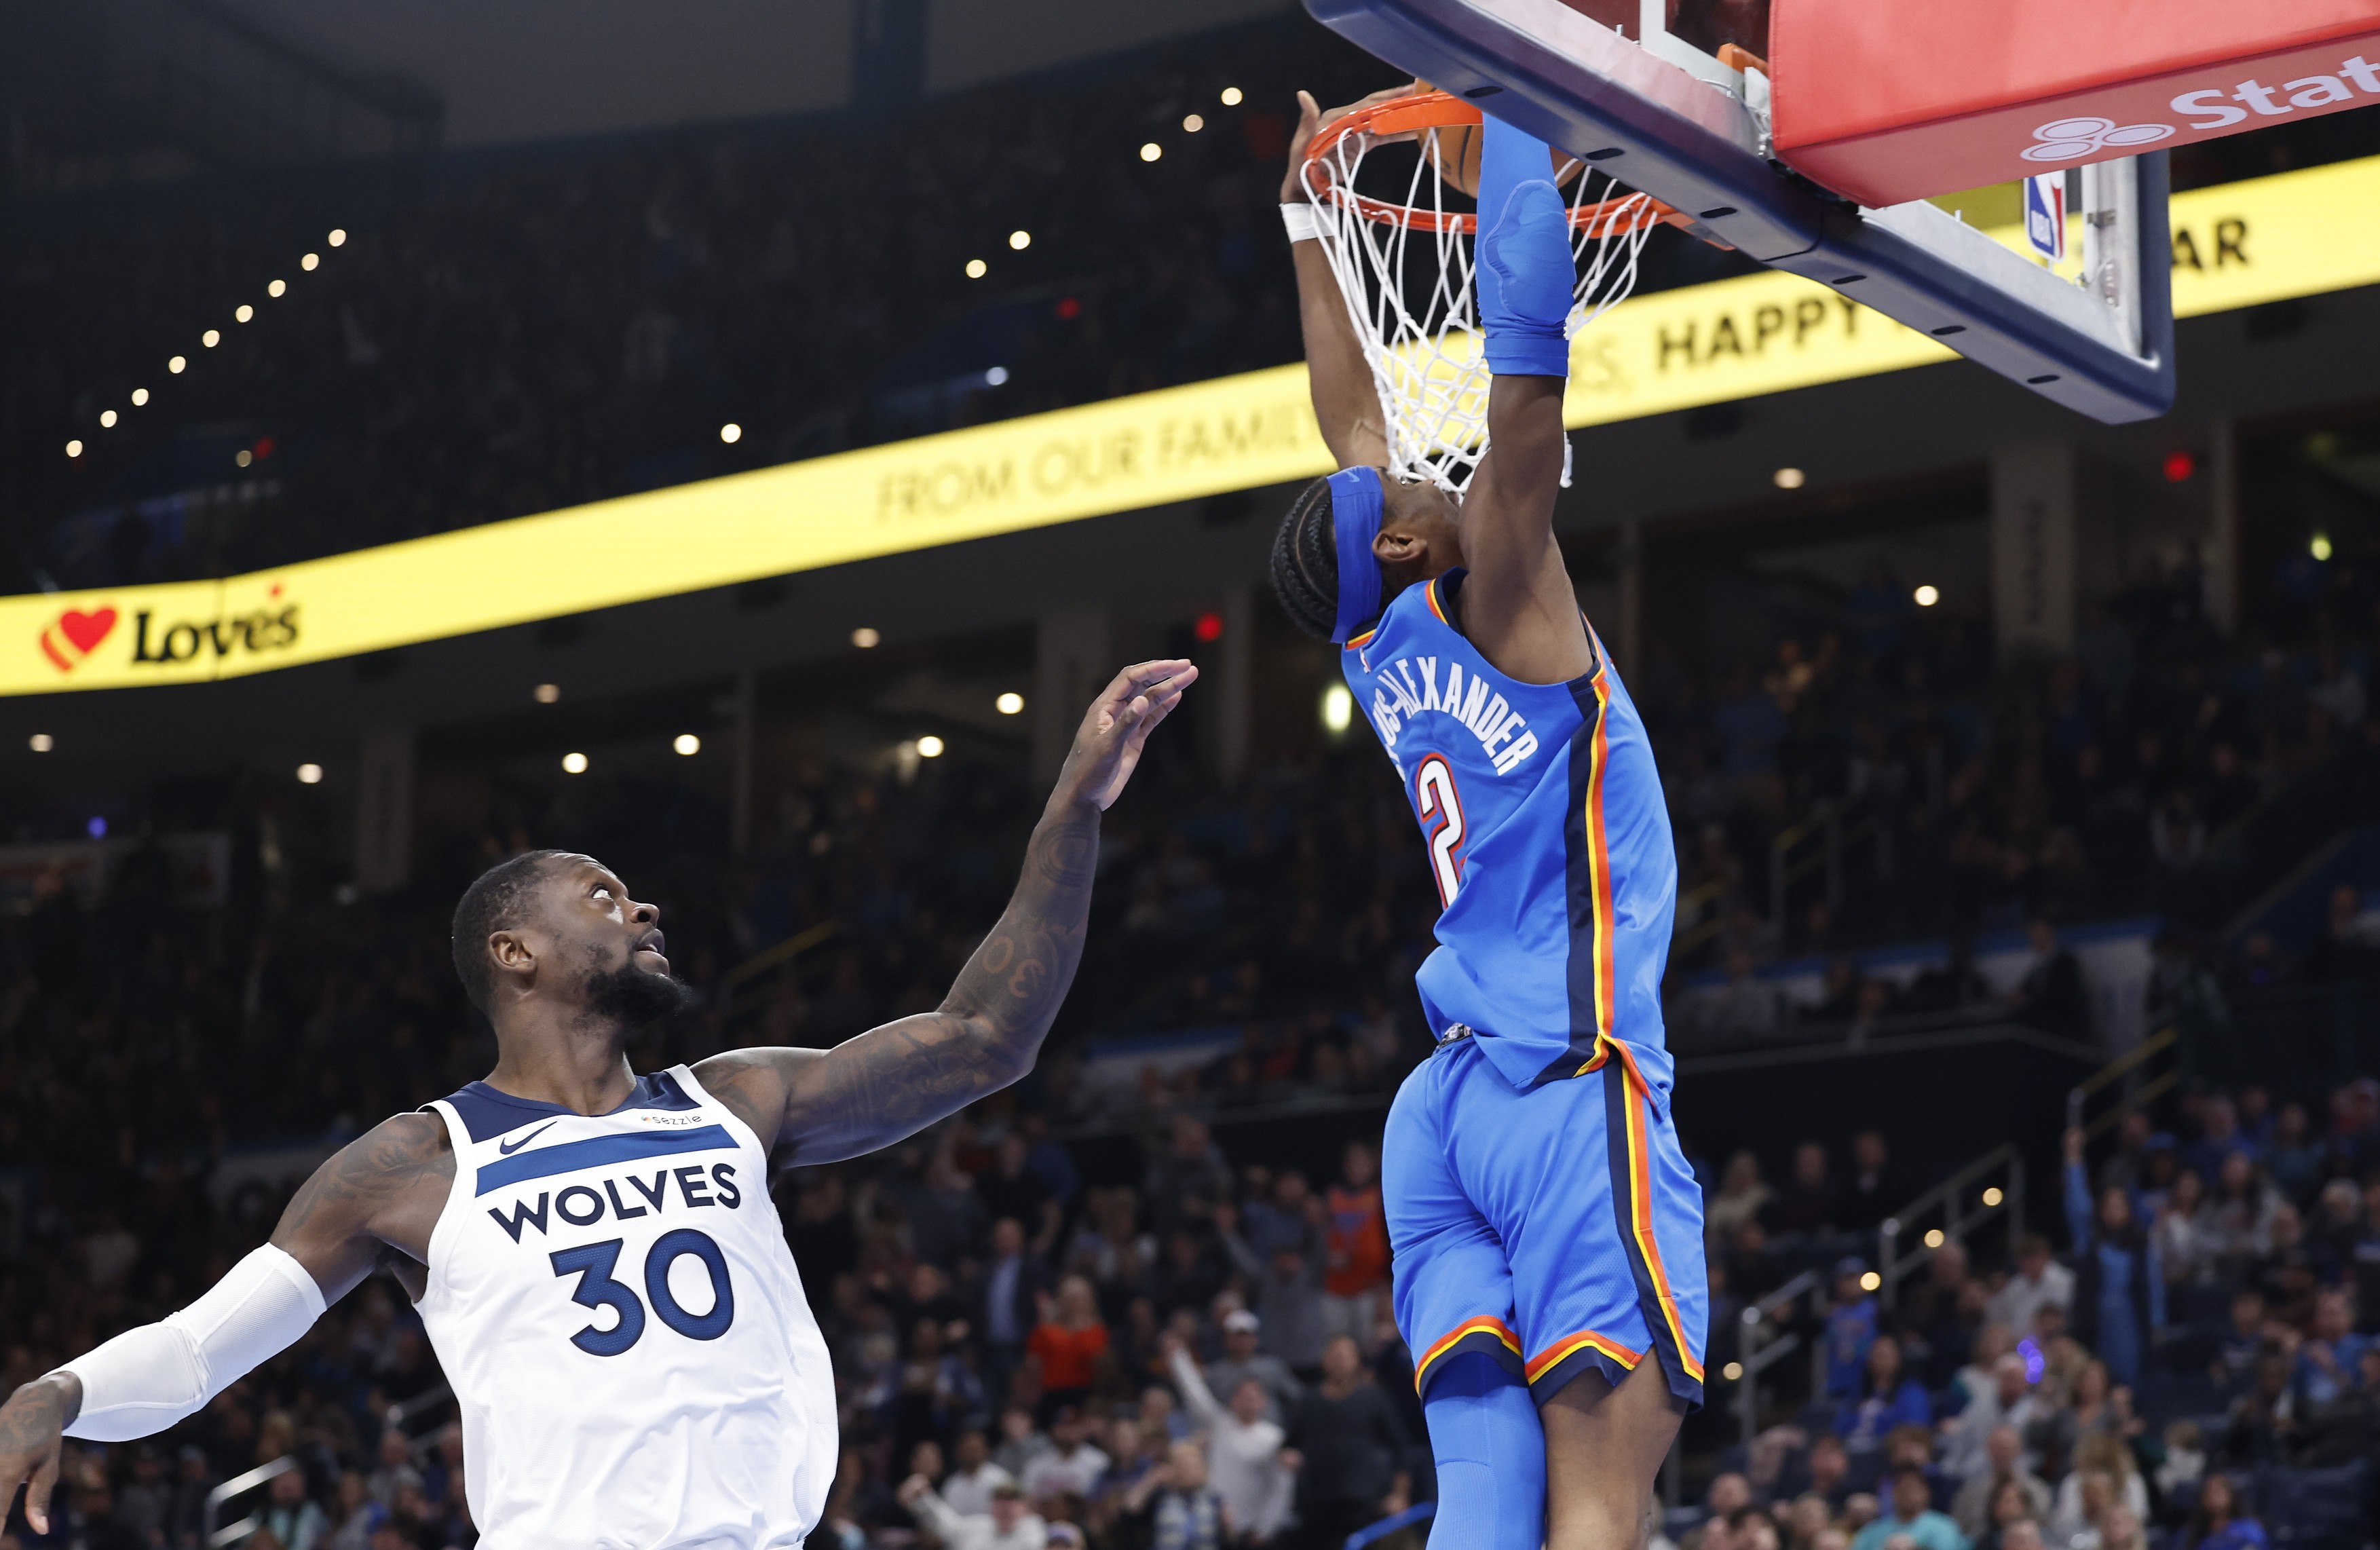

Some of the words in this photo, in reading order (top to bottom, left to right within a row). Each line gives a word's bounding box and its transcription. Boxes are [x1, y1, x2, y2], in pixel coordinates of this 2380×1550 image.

[877, 458, 1015, 519] FROM
[1033, 428, 1140, 494] OUR
[1657, 295, 1859, 371] HAPPY
[1415, 752, 1467, 909] 2
[652, 1116, 702, 1125] sezzle
[487, 1162, 740, 1245] WOLVES
[548, 1228, 734, 1357] 30
